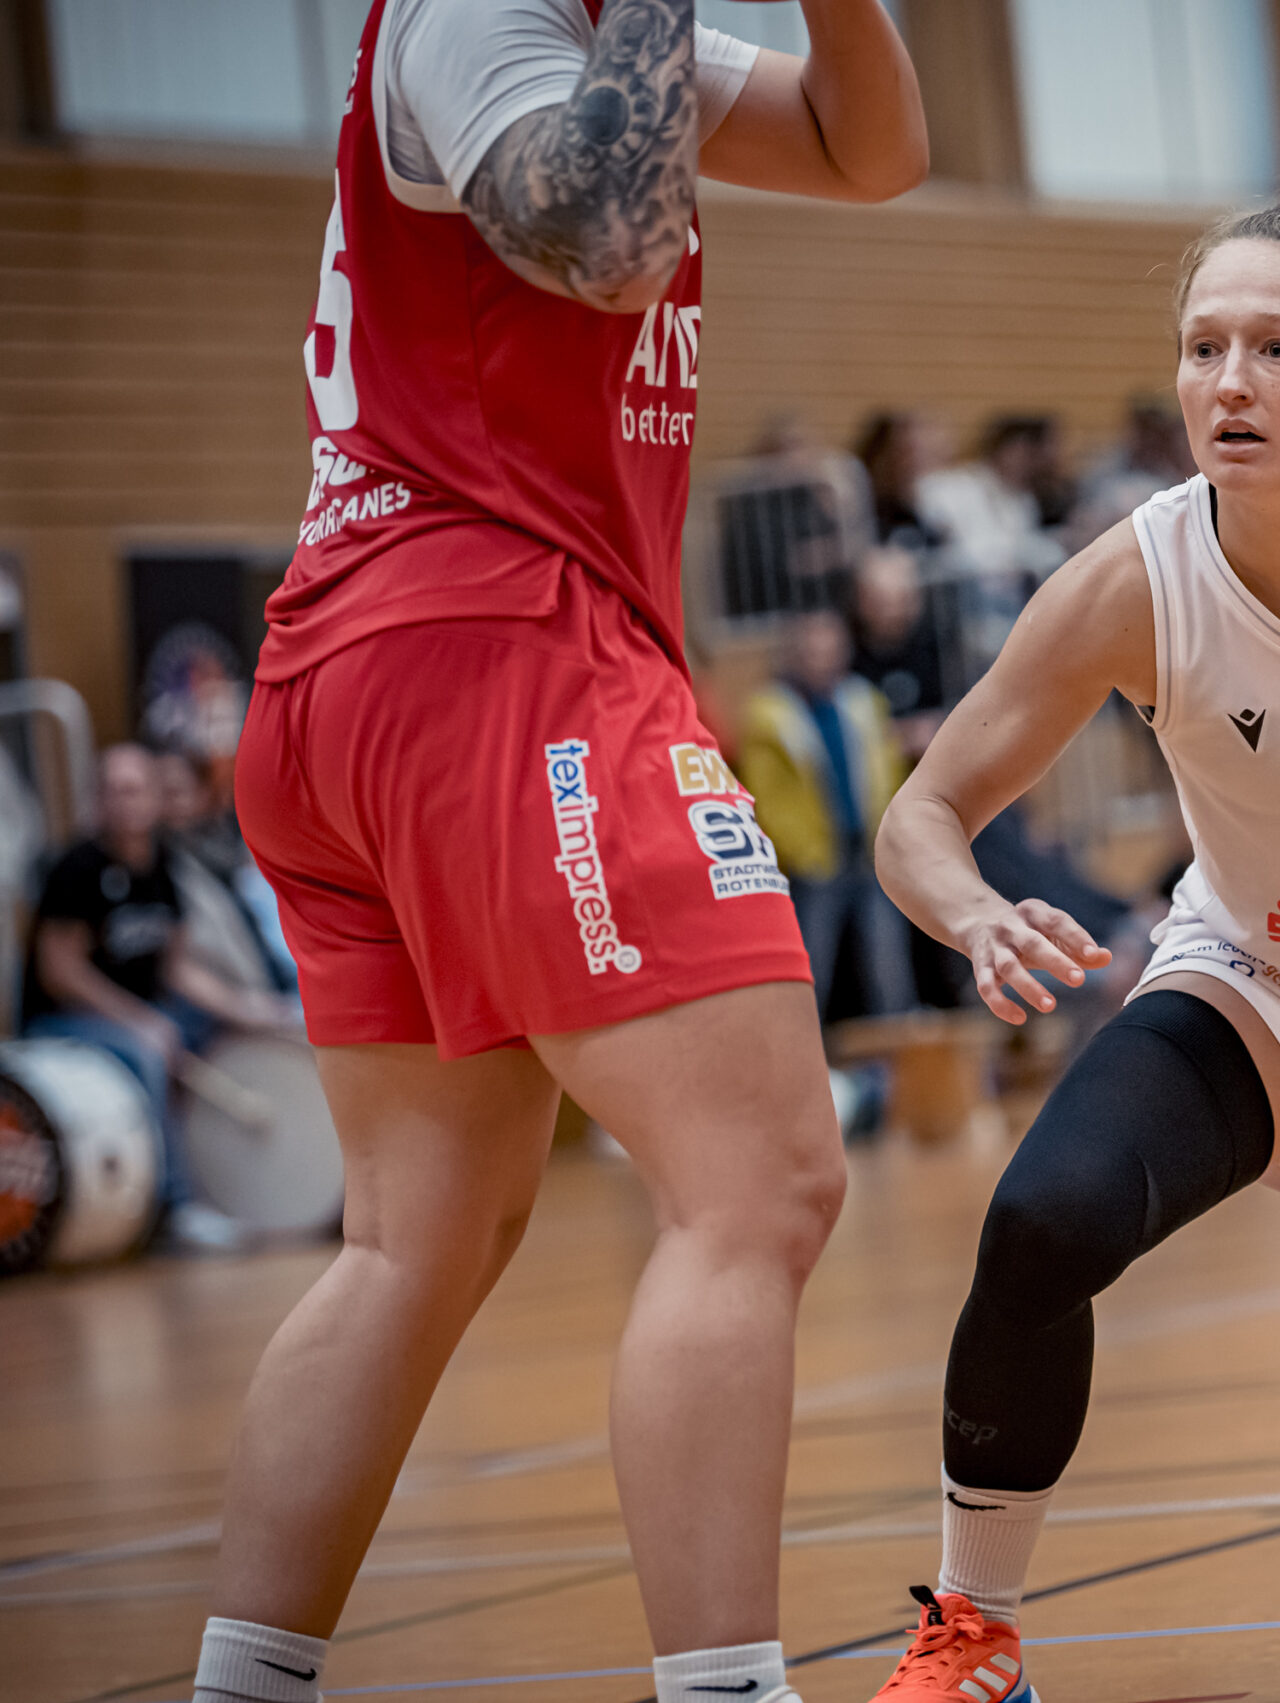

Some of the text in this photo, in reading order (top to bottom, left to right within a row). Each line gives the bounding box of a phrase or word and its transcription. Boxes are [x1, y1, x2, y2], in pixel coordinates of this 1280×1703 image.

[621, 392, 694, 446] better
[674, 745, 740, 794] EW
[945, 1408, 999, 1446] cep
